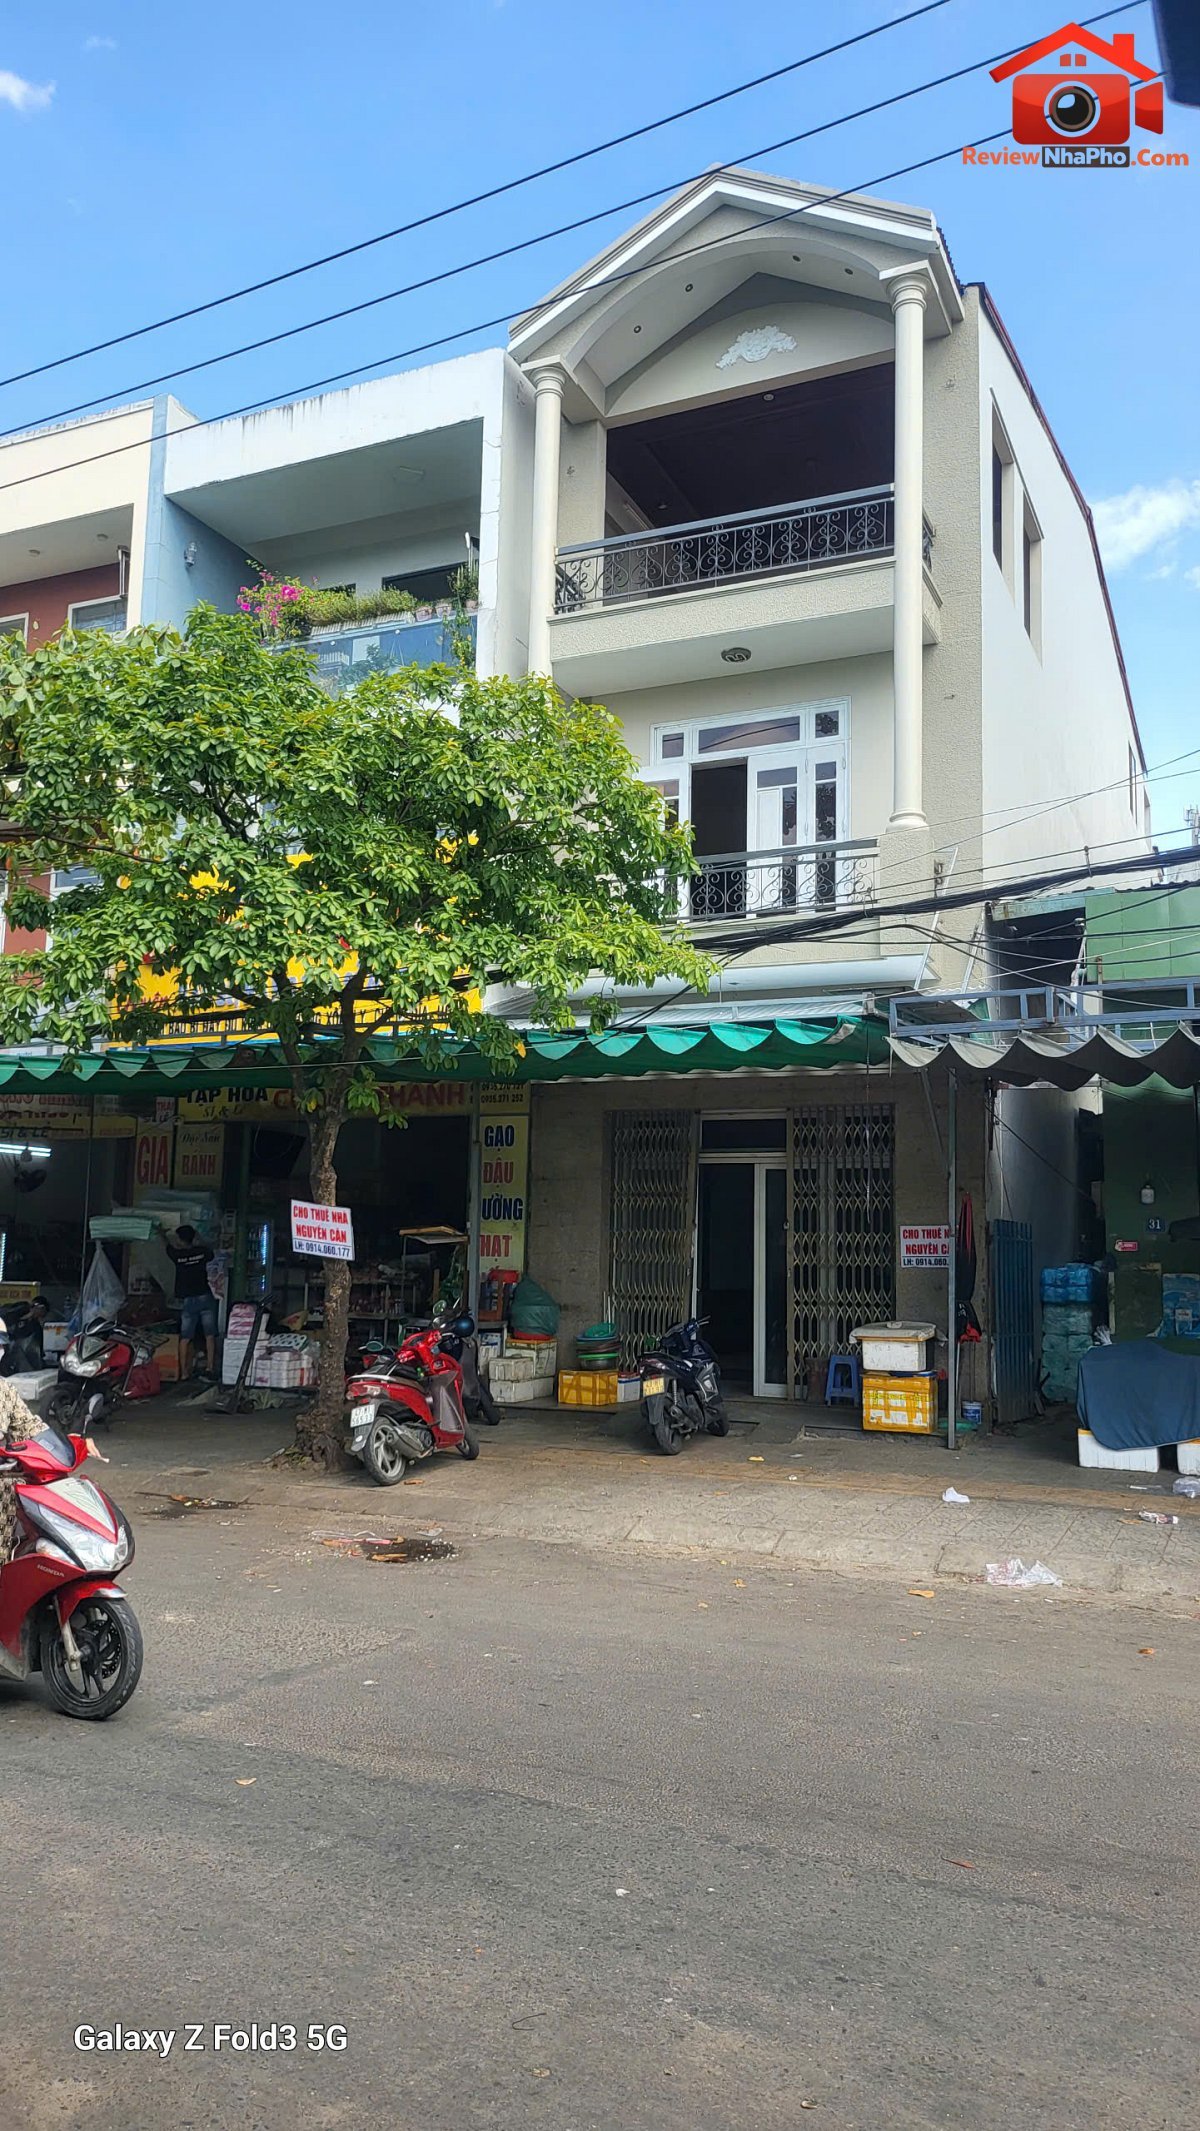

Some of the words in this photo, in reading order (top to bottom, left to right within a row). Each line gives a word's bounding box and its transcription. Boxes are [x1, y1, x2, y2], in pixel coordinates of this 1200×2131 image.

[293, 1205, 309, 1220] CHO
[310, 1207, 330, 1222] THUÊ
[1148, 1218, 1161, 1230] 31
[296, 1224, 328, 1241] NGUYÊN
[902, 1229, 919, 1240] CHO
[921, 1227, 942, 1240] THUÊ
[905, 1242, 939, 1255] NGUYÊN
